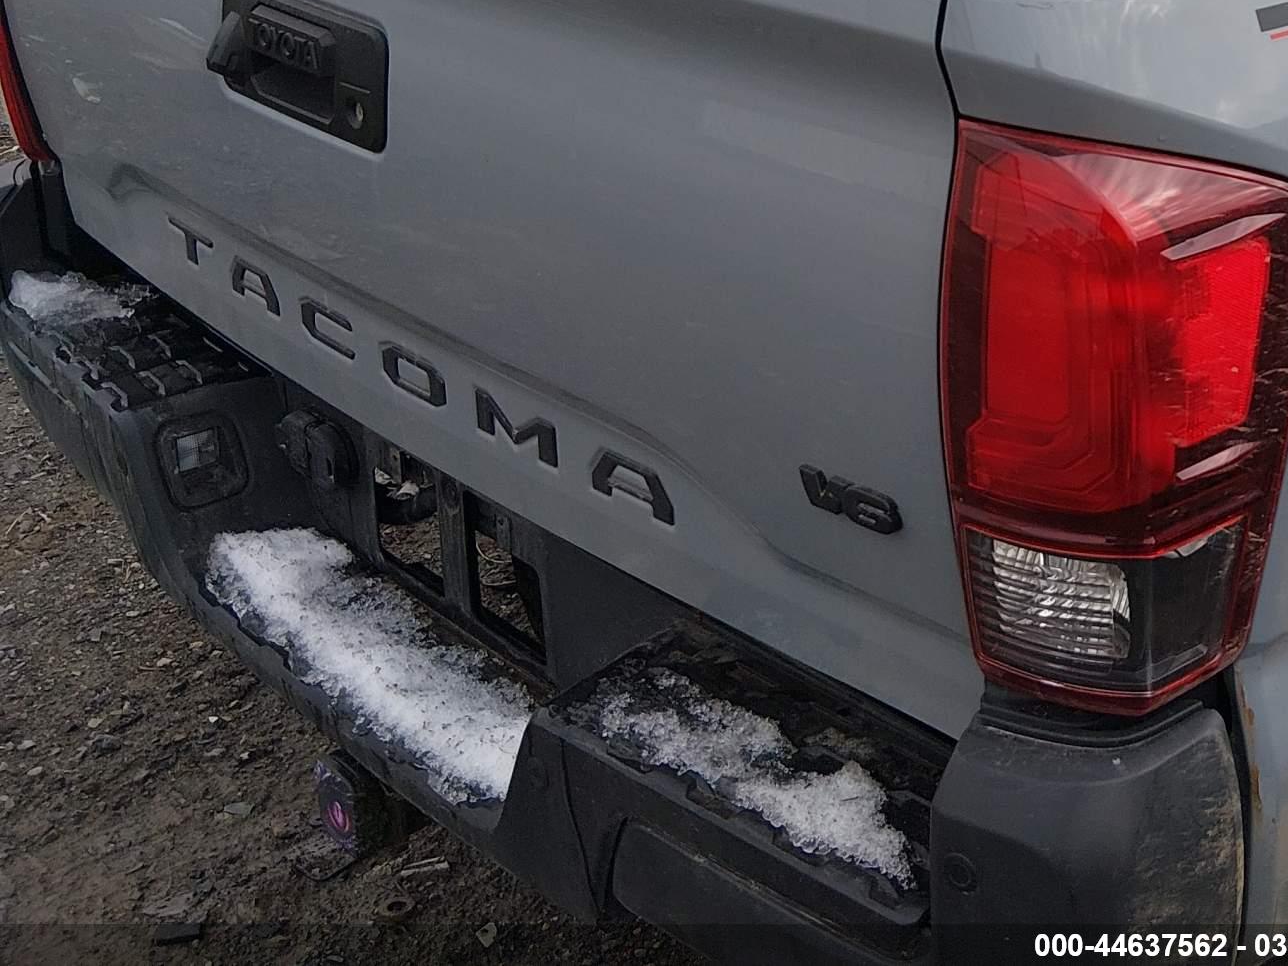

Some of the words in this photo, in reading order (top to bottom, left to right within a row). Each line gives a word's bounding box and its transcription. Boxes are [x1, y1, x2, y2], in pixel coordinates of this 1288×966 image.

[248, 17, 321, 72] TOYOTA
[168, 214, 676, 527] TACOMA
[798, 464, 904, 535] V6
